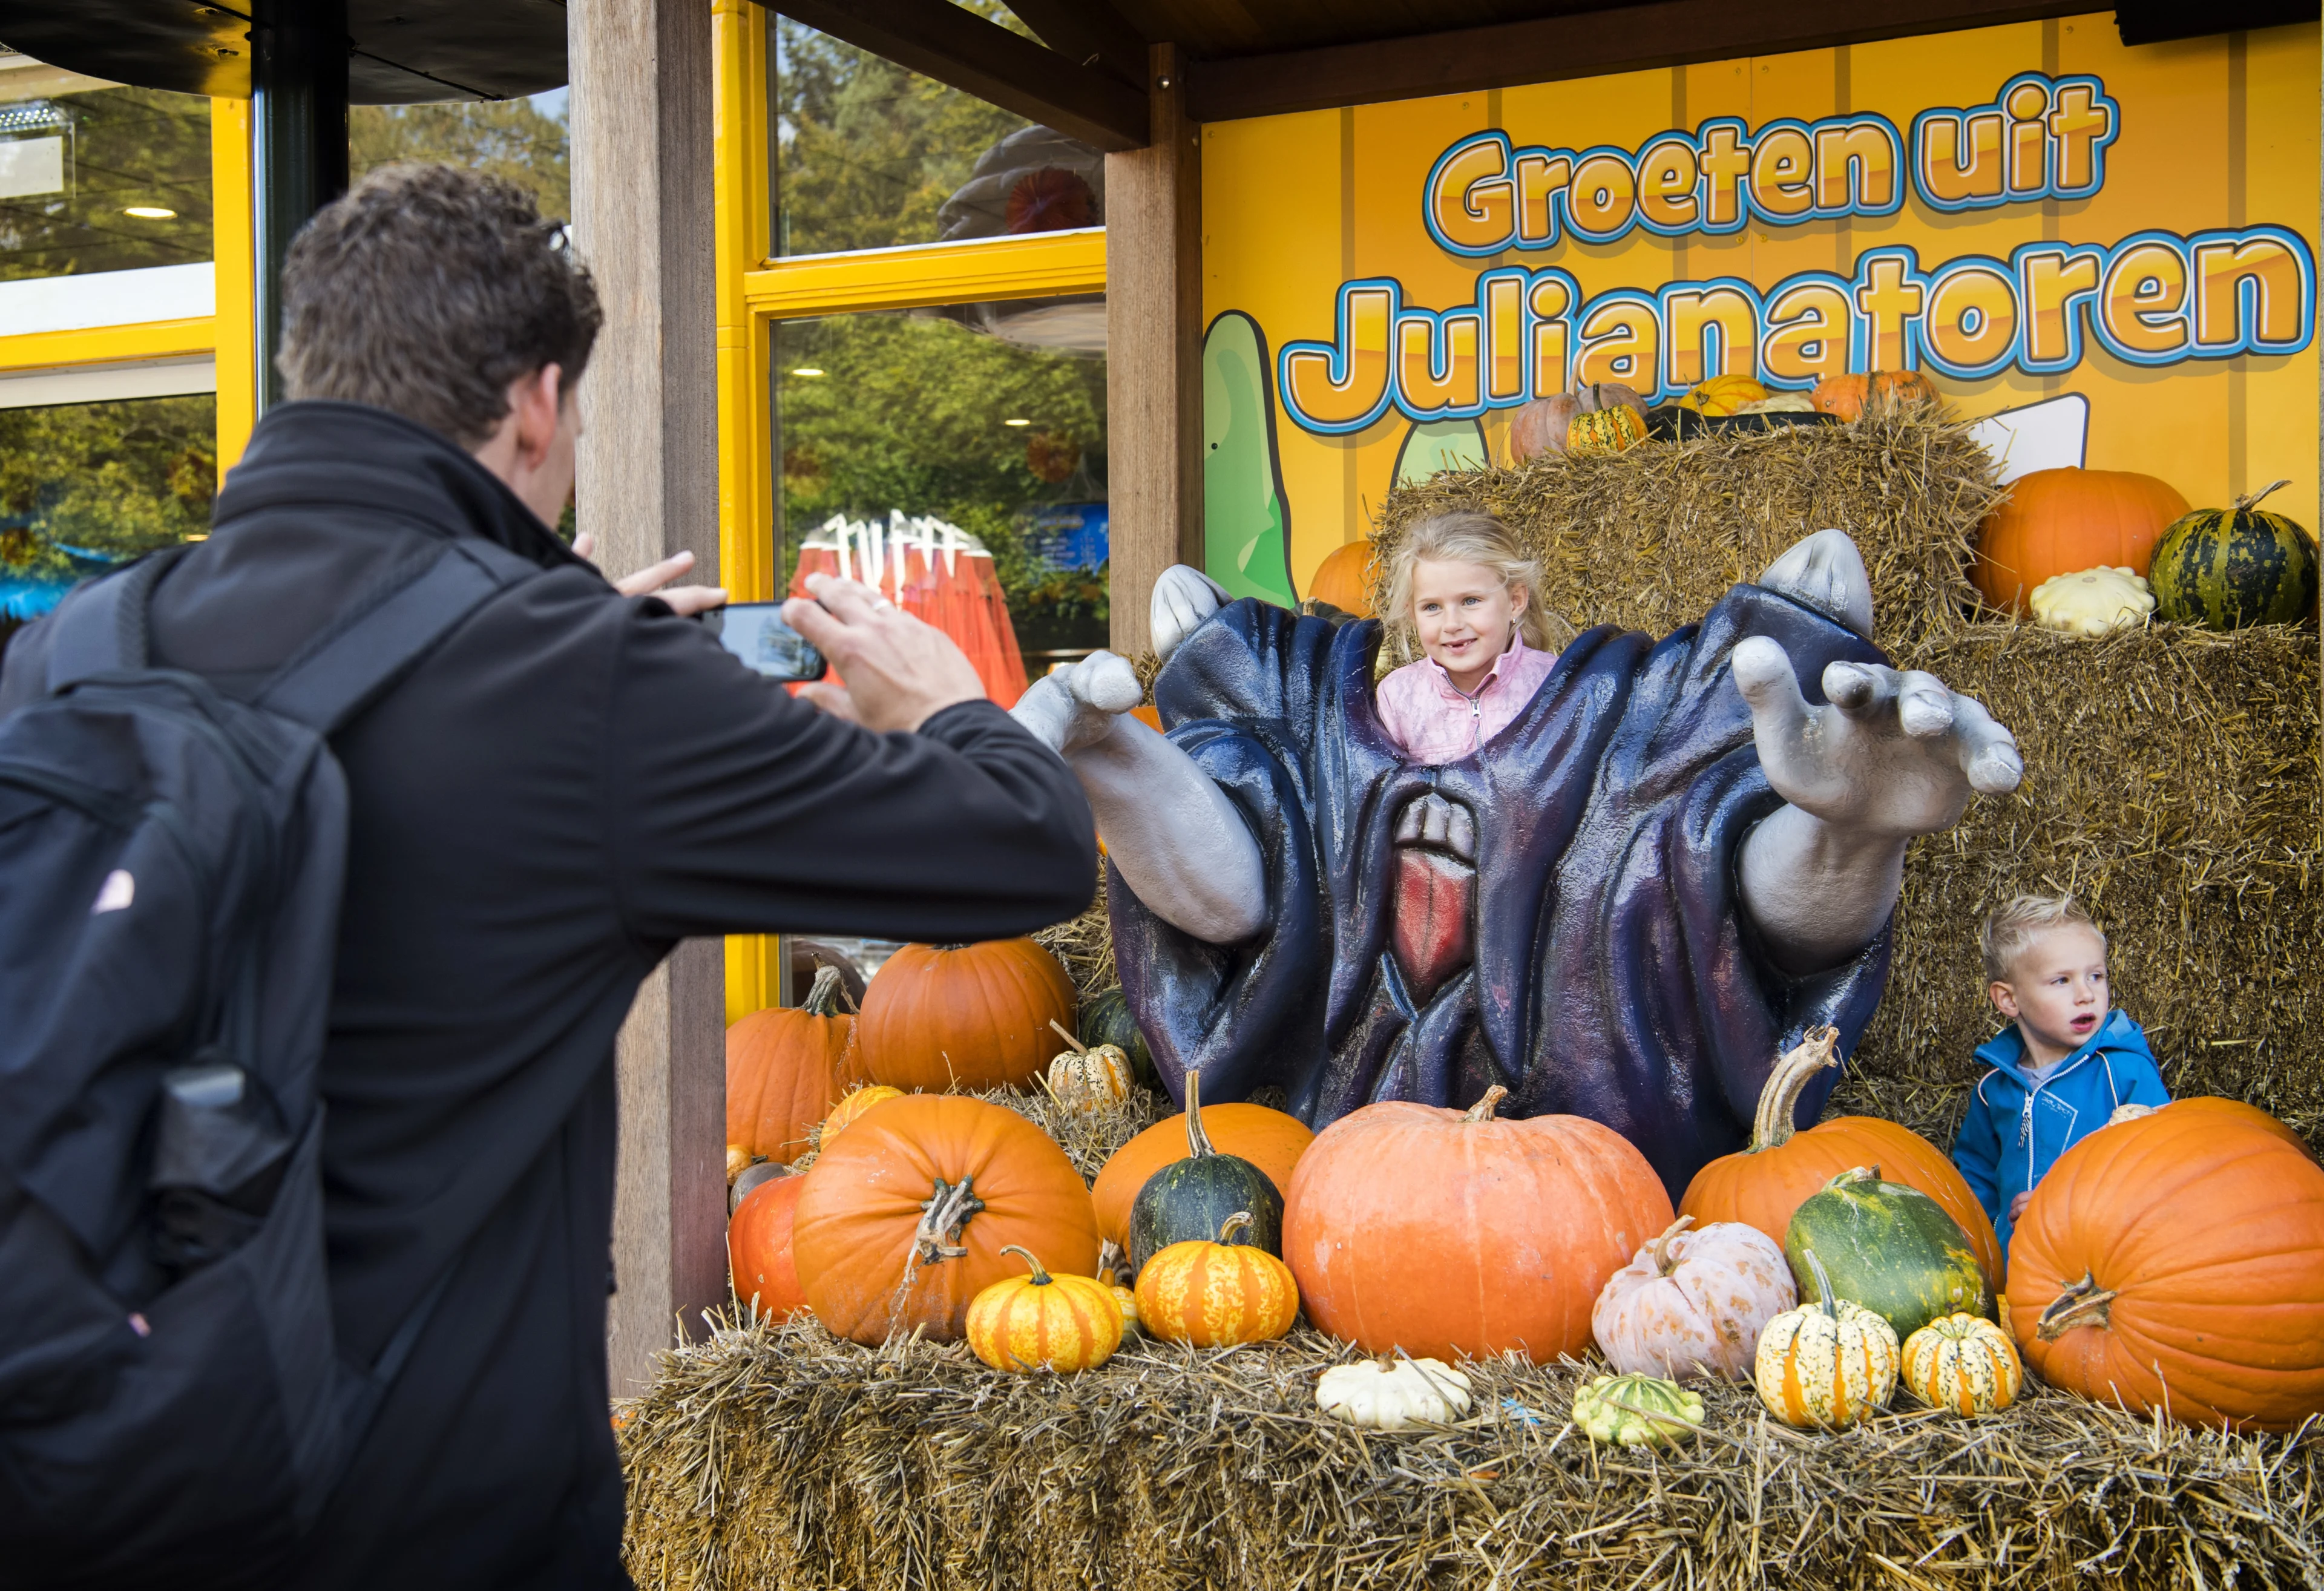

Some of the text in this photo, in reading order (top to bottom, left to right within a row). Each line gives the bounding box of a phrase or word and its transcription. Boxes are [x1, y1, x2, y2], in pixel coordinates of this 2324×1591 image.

[1423, 70, 2120, 258] Groeten uit
[1278, 223, 2316, 436] Julianatoren
